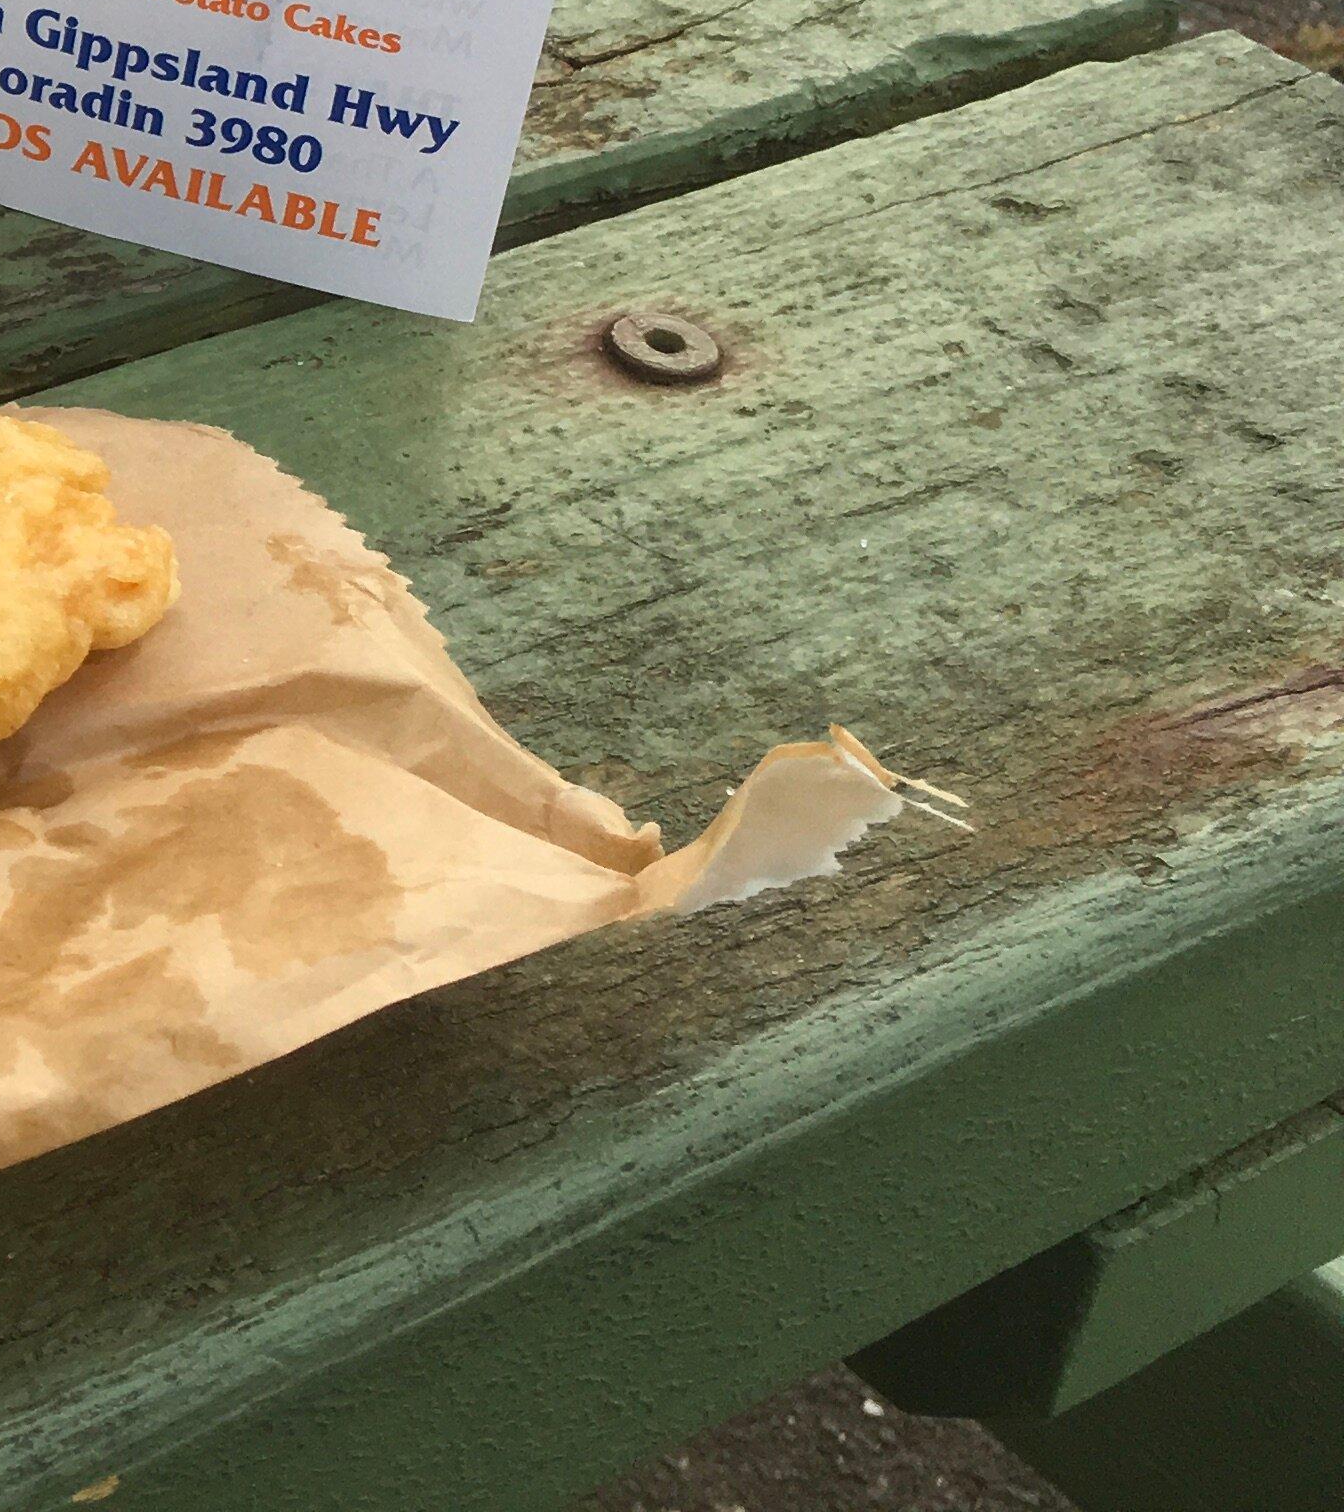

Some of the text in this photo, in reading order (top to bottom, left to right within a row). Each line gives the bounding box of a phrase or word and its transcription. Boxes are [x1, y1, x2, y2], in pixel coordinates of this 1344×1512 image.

[283, 2, 403, 55] Cakes
[24, 7, 310, 116] Gippsland
[326, 83, 462, 155] Hwy
[185, 107, 324, 174] 3980
[71, 141, 383, 249] AVAILABLE
